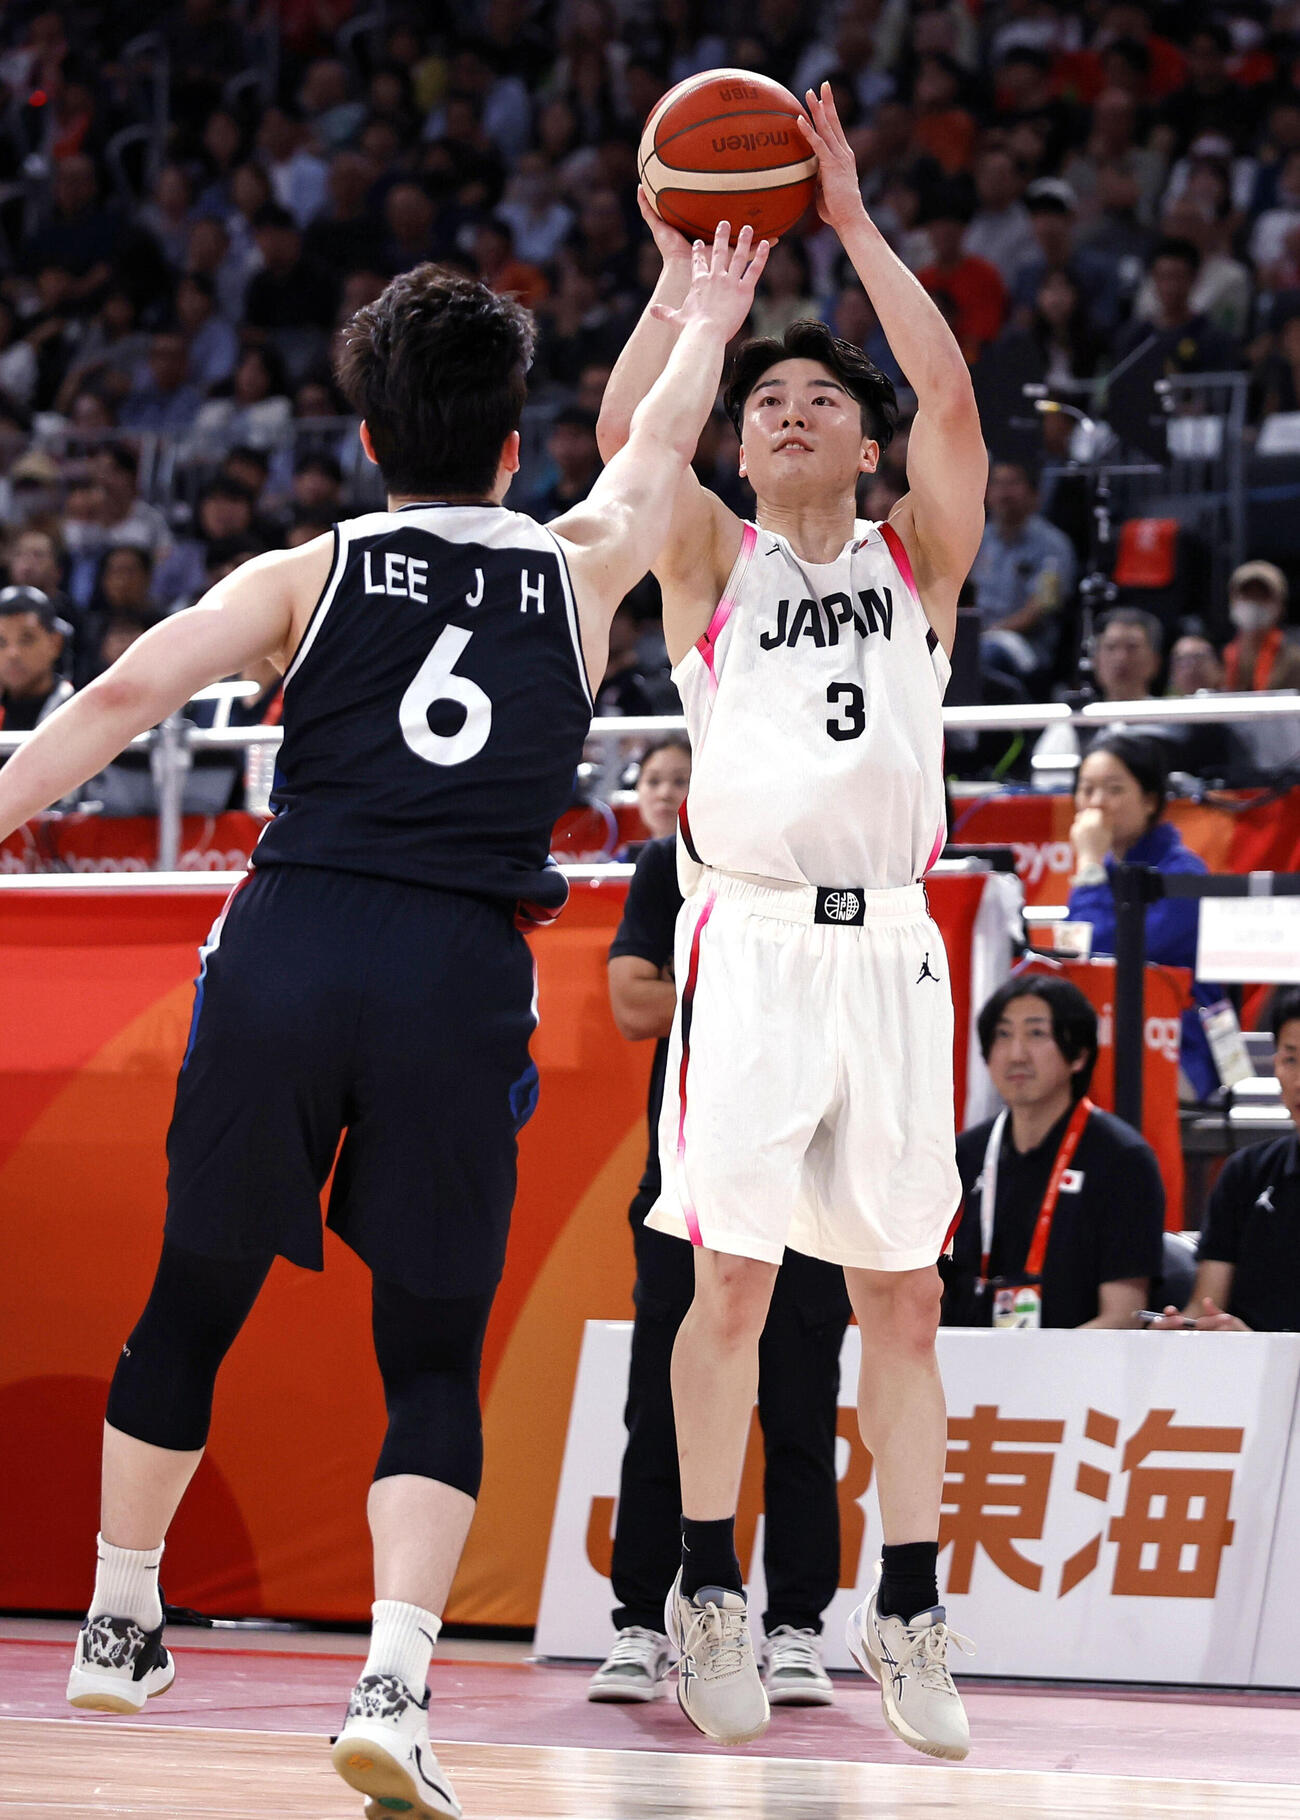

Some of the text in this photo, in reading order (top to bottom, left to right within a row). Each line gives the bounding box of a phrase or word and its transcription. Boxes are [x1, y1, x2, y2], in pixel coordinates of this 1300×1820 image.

[719, 86, 758, 102] FIBA
[711, 131, 790, 153] molten
[364, 551, 545, 614] LEE J H
[399, 623, 492, 767] 6
[826, 681, 866, 742] 3
[585, 1404, 1245, 1599] R東海
